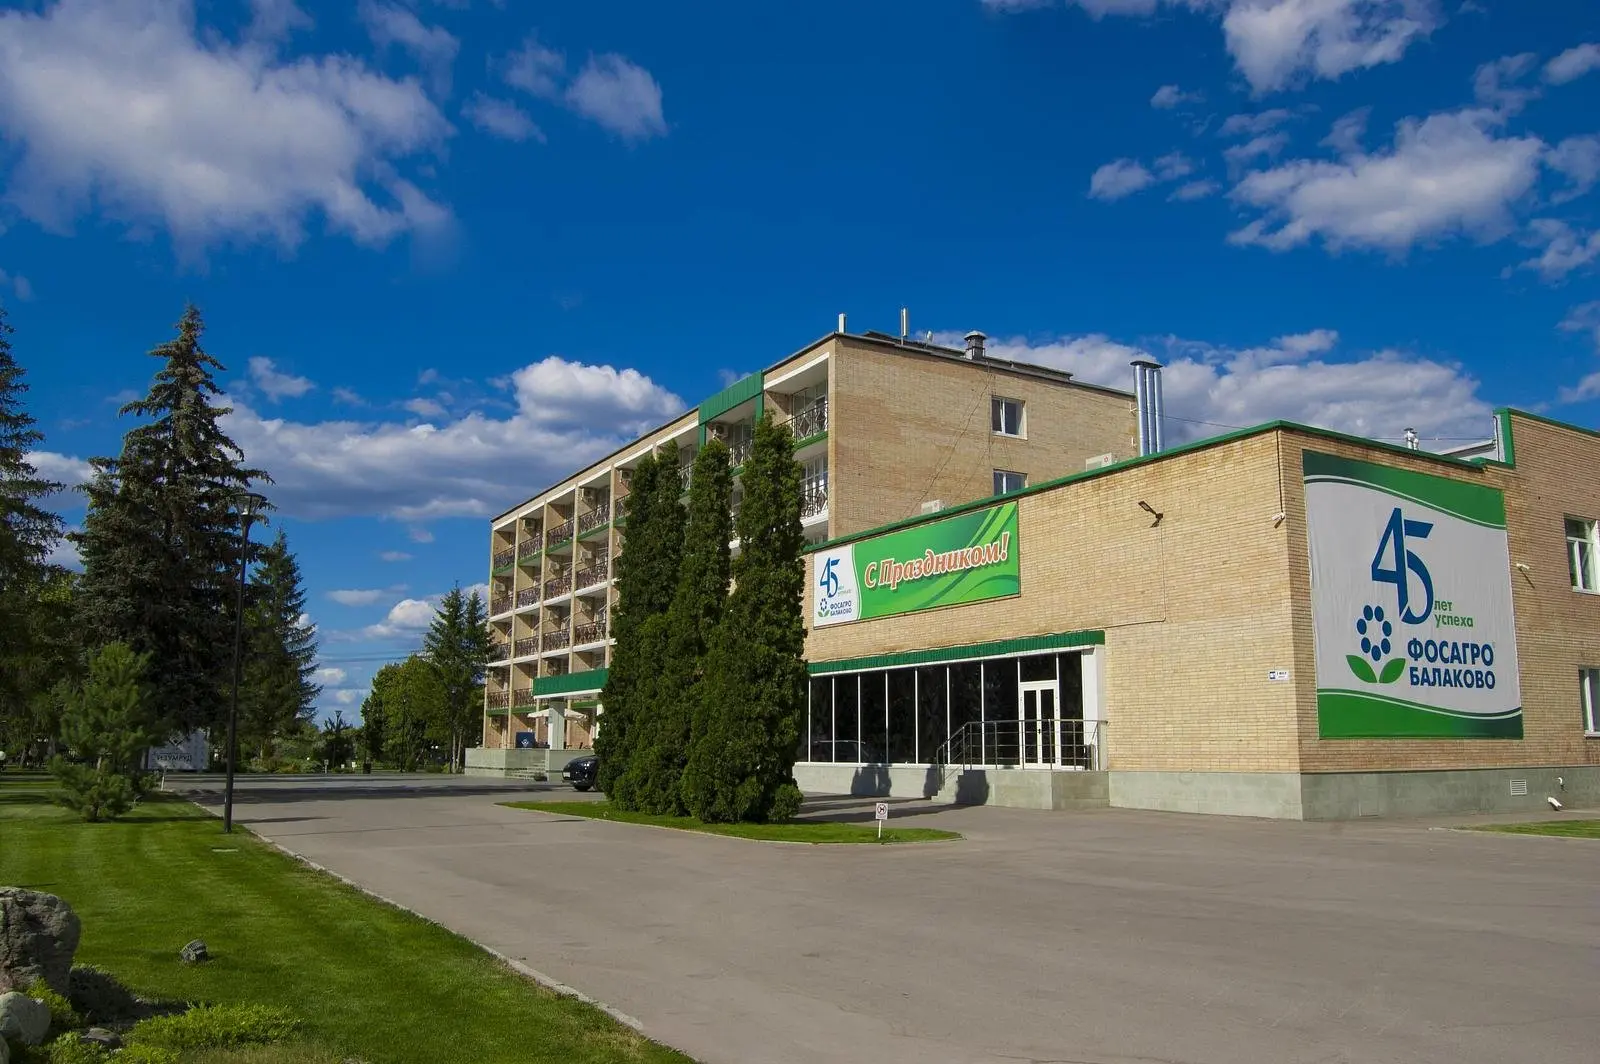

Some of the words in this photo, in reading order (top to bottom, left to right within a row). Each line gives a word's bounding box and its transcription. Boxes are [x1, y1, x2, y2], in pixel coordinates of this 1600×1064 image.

[864, 561, 877, 588] С
[878, 531, 1010, 589] Праздником!
[1371, 507, 1434, 625] 45
[819, 557, 840, 598] 45
[1434, 600, 1453, 612] лет
[1434, 613, 1474, 628] успеха
[1407, 638, 1494, 666] ФОСАГРО
[1409, 667, 1496, 689] БАЛАКОВО
